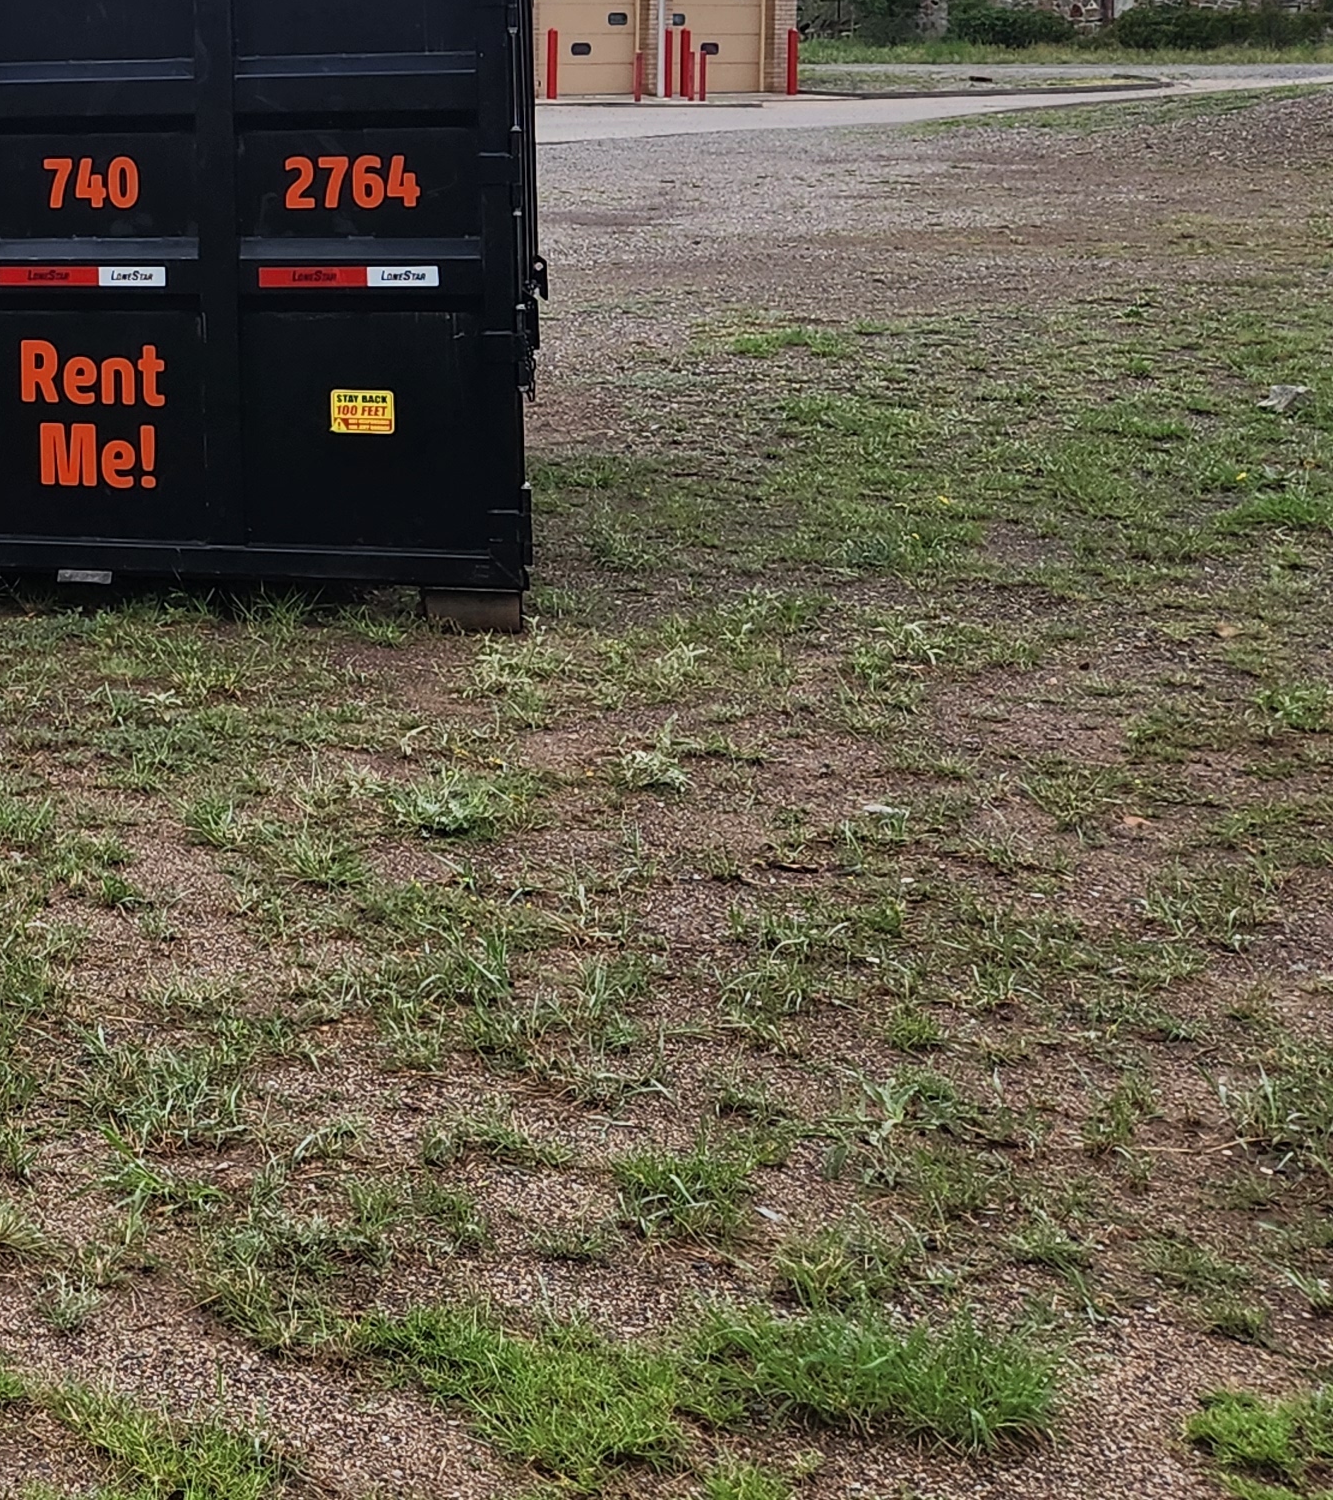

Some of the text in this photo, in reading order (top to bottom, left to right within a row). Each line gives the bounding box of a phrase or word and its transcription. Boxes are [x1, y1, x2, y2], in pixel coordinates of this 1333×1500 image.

[43, 155, 140, 210] 740
[284, 155, 421, 210] 2764
[20, 339, 166, 407] Rent
[336, 394, 388, 404] STAY BACK
[336, 405, 388, 417] 100 FEET
[39, 422, 157, 489] Me!
